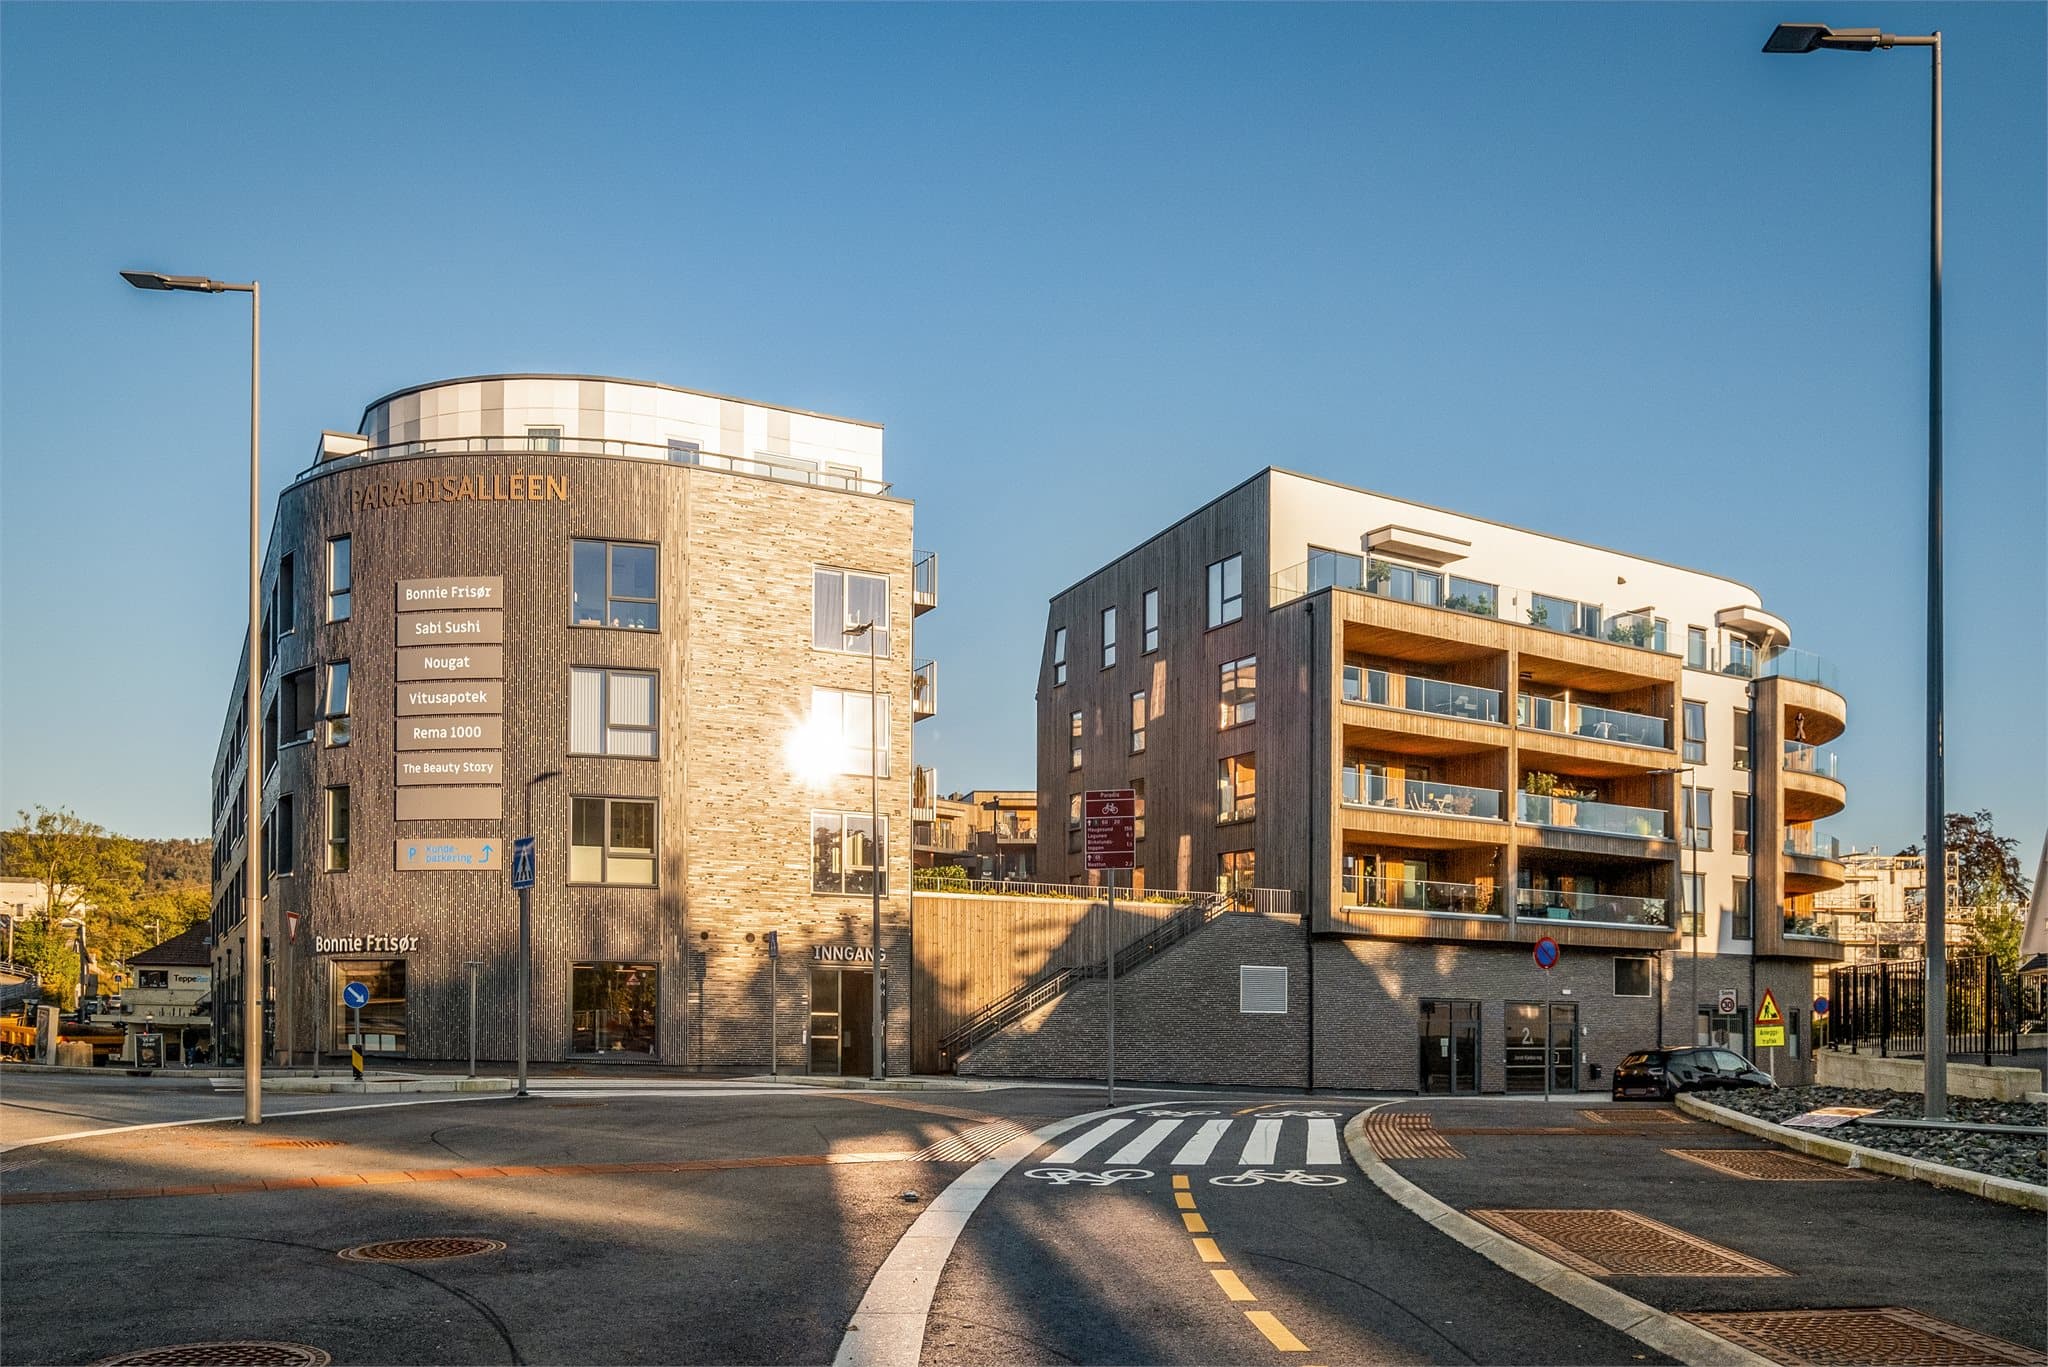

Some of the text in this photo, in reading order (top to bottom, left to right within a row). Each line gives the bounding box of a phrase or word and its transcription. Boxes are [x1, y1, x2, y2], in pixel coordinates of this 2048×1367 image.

[351, 469, 568, 512] PARADISALLÉEN
[406, 585, 492, 601] Bonnie Frisør
[415, 620, 481, 635] Sabi Sushi
[424, 656, 470, 671] Nougat
[408, 691, 488, 706] Vitusapotek
[413, 726, 482, 739] Rema 1000
[403, 762, 494, 774] The Beauty Story
[316, 933, 419, 953] Bonnie Frisør
[814, 946, 887, 962] INNGANG
[1723, 1001, 1732, 1009] 30
